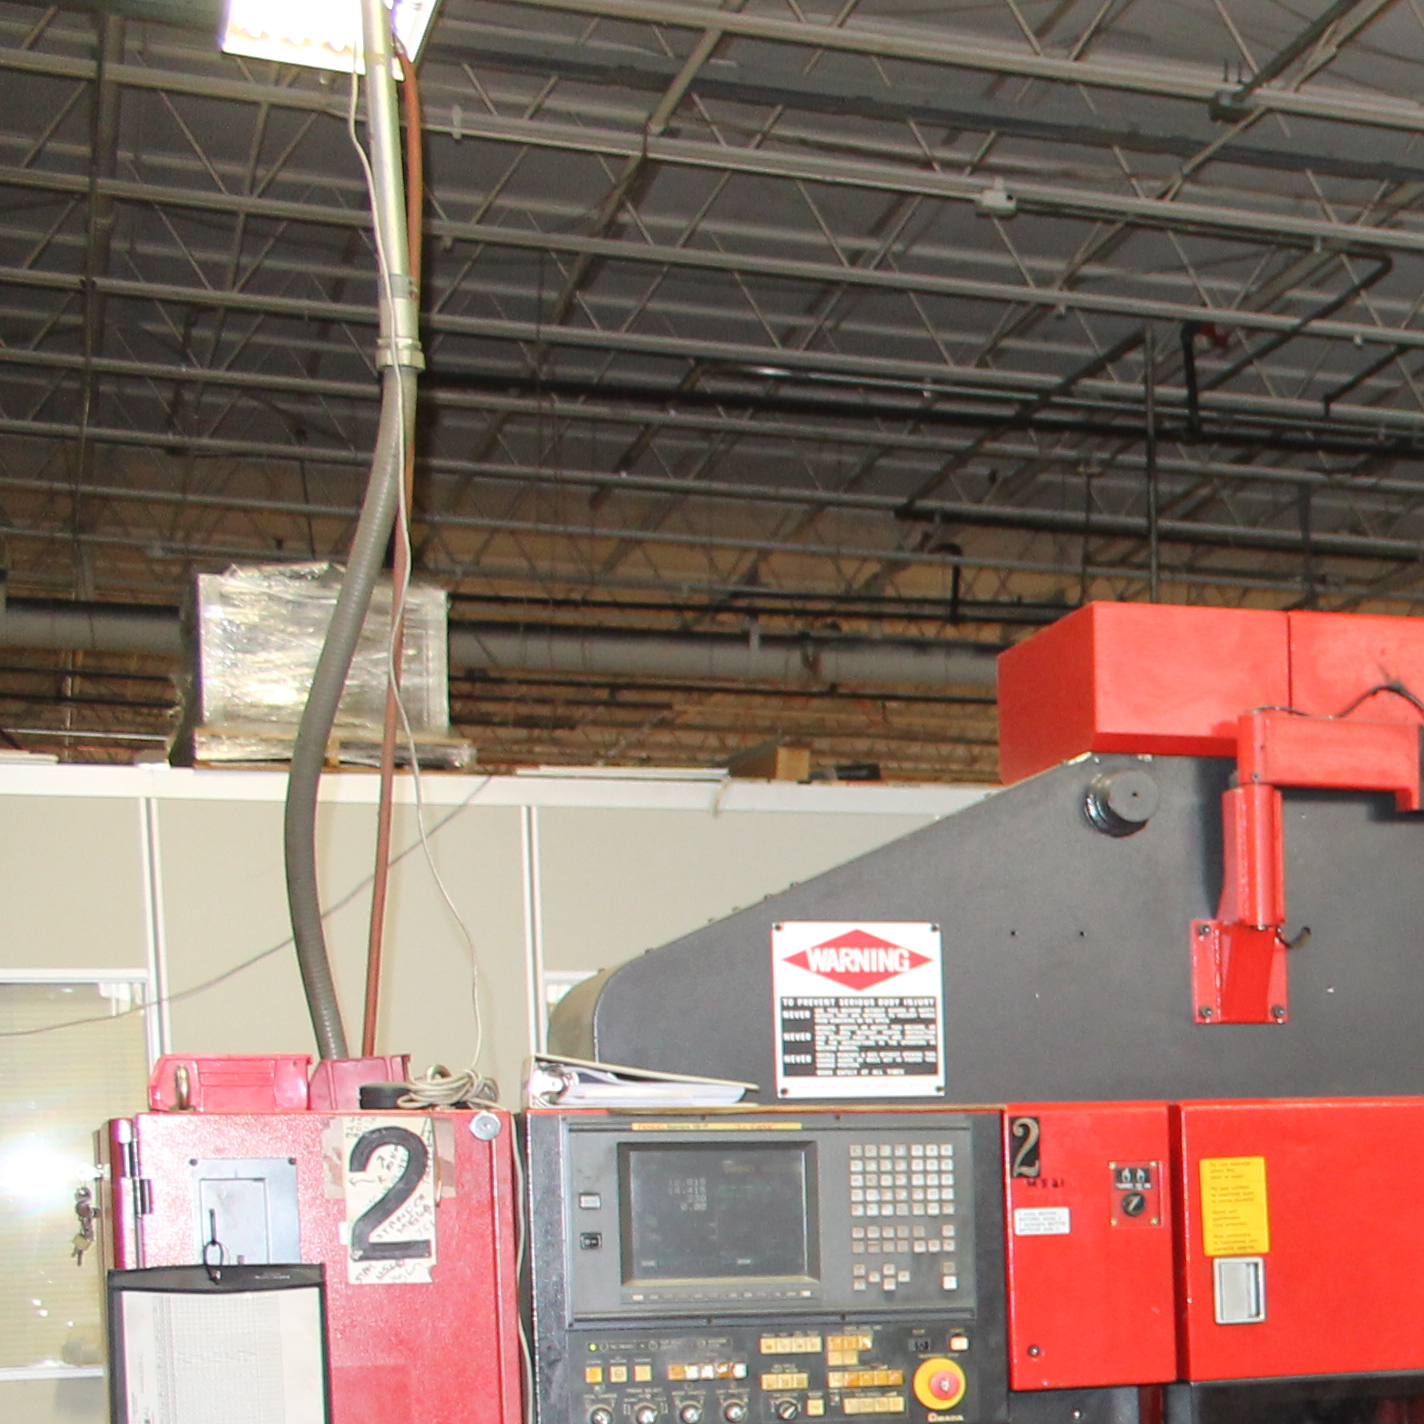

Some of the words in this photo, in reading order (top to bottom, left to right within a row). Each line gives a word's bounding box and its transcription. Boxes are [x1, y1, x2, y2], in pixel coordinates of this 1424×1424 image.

[805, 946, 911, 974] WARNING
[1012, 1116, 1040, 1178] 2
[349, 1125, 432, 1263] 2
